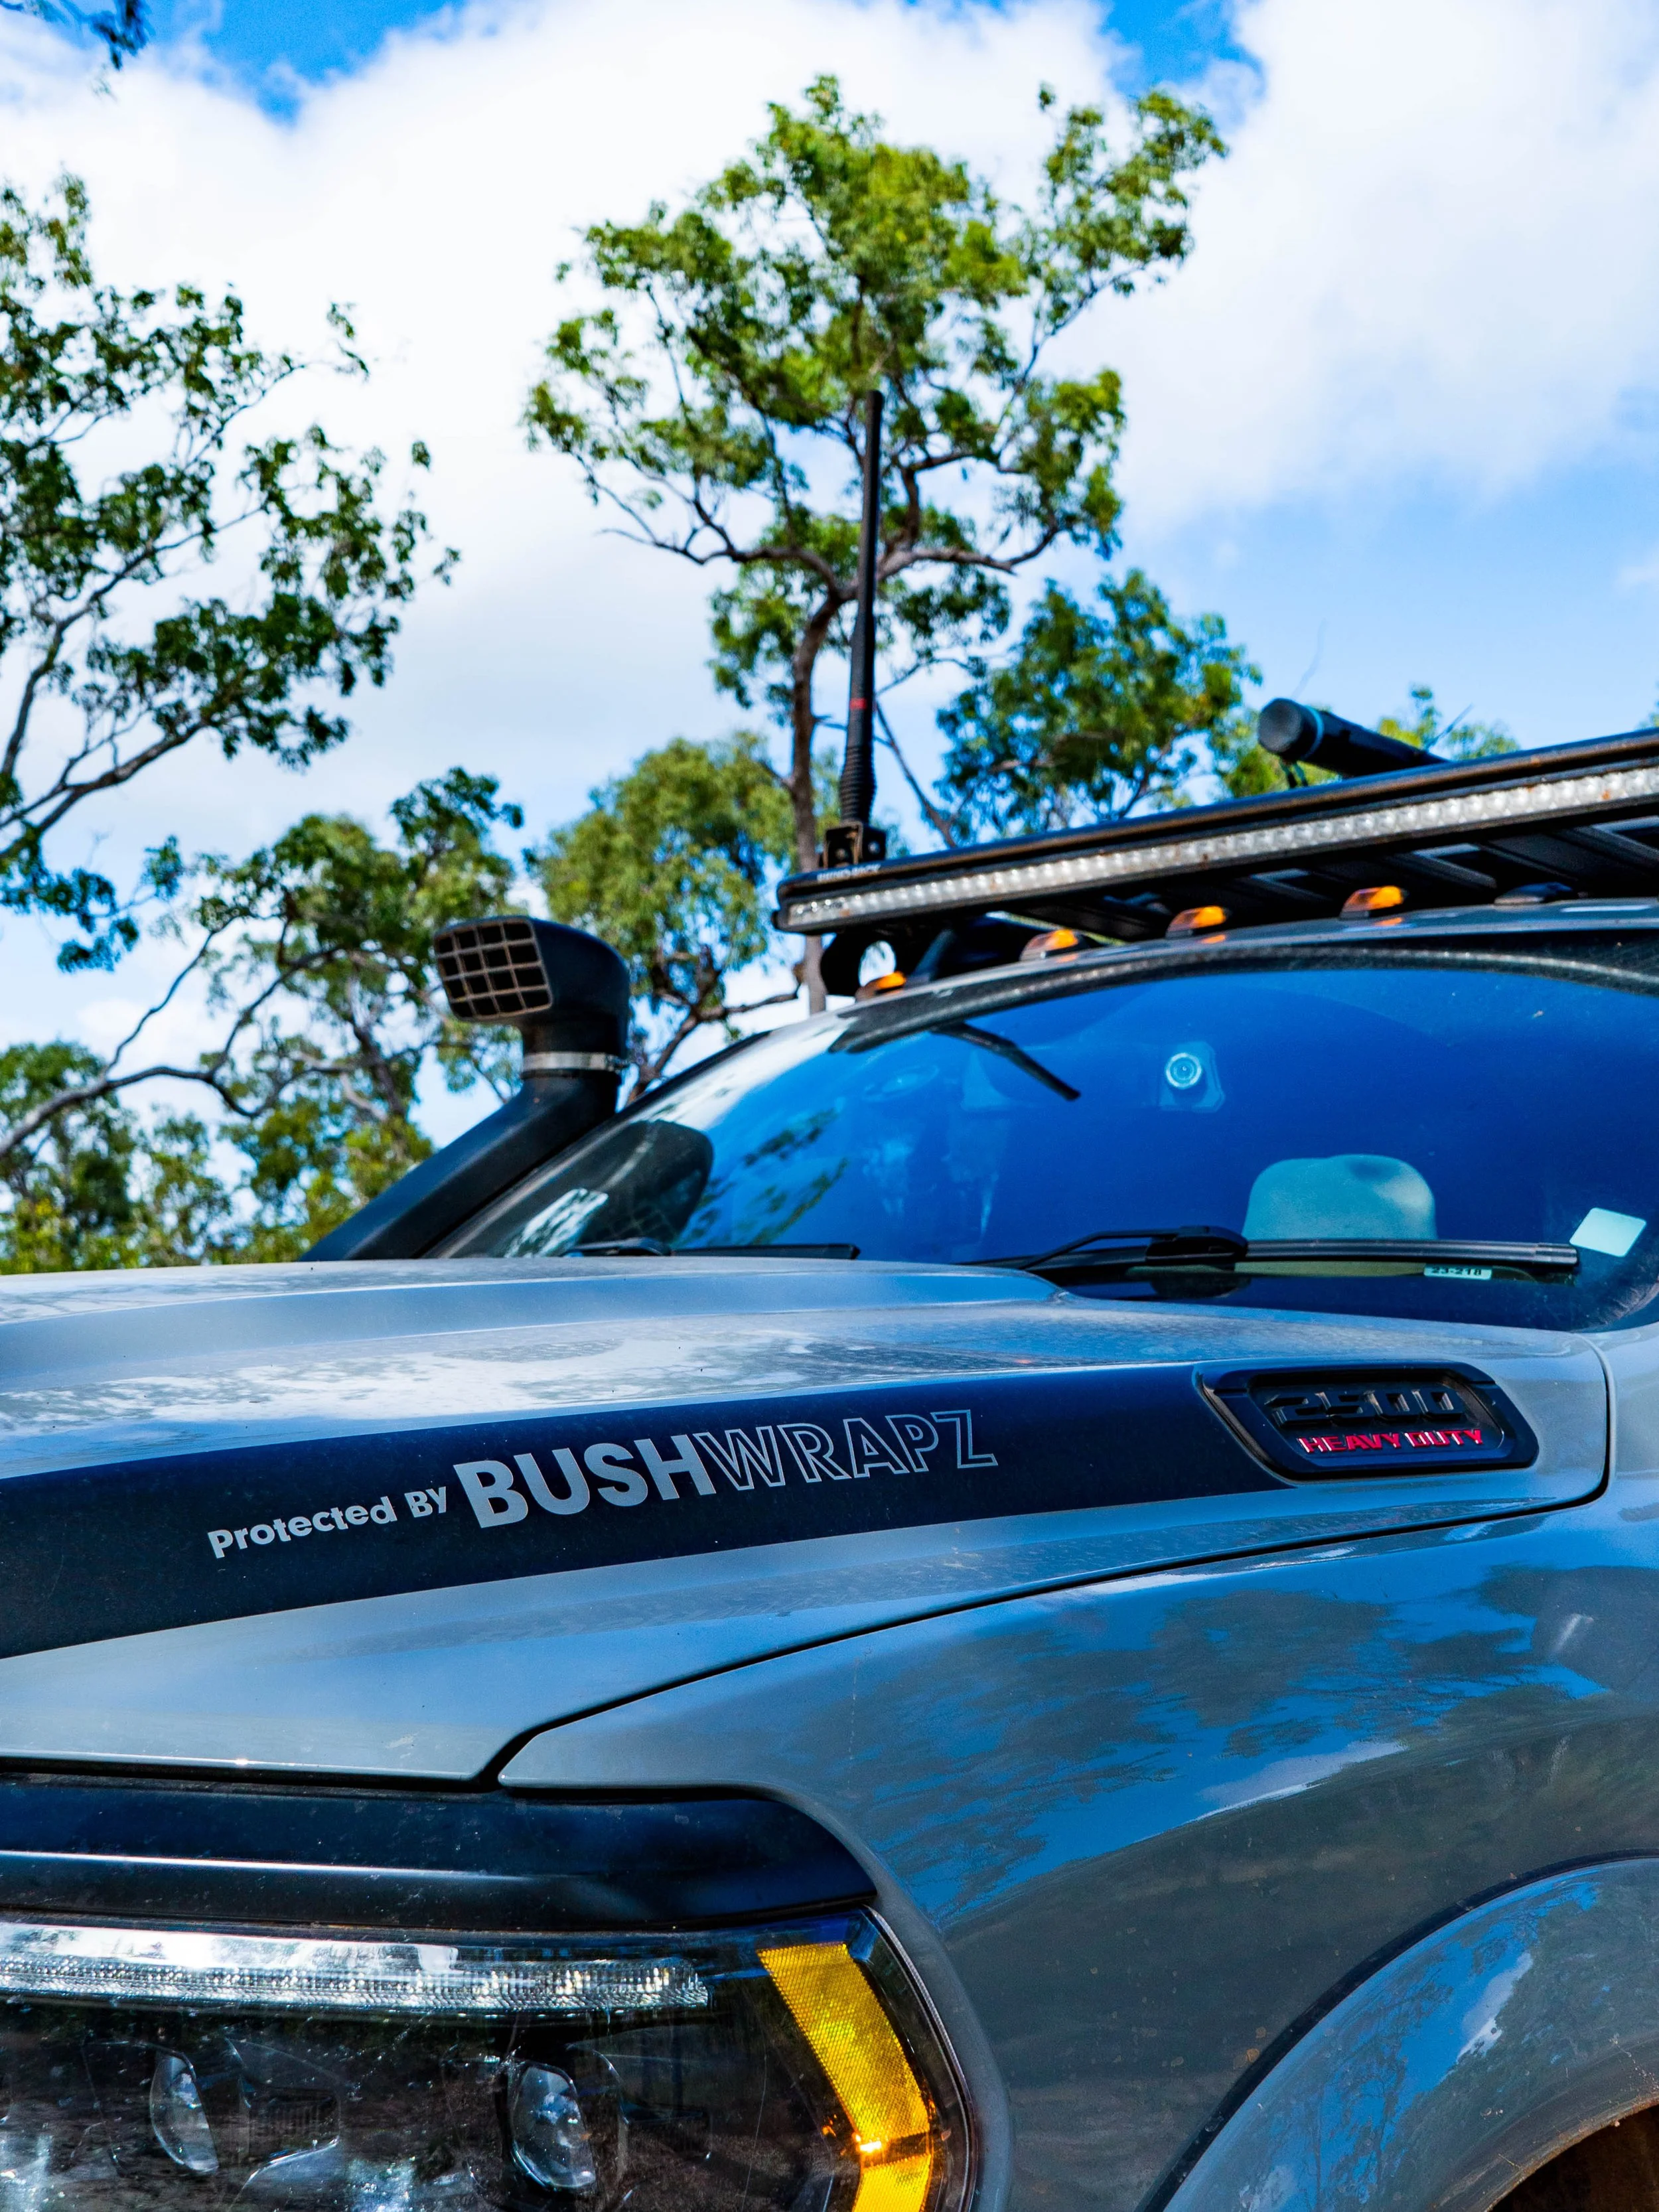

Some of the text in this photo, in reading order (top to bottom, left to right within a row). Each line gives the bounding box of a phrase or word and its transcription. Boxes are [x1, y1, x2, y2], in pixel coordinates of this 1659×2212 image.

[1263, 1389, 1463, 1428] 2500
[1297, 1428, 1484, 1453] HEAVY DUTY
[208, 1409, 998, 1558] Protected BY BUSHWRAPZ
